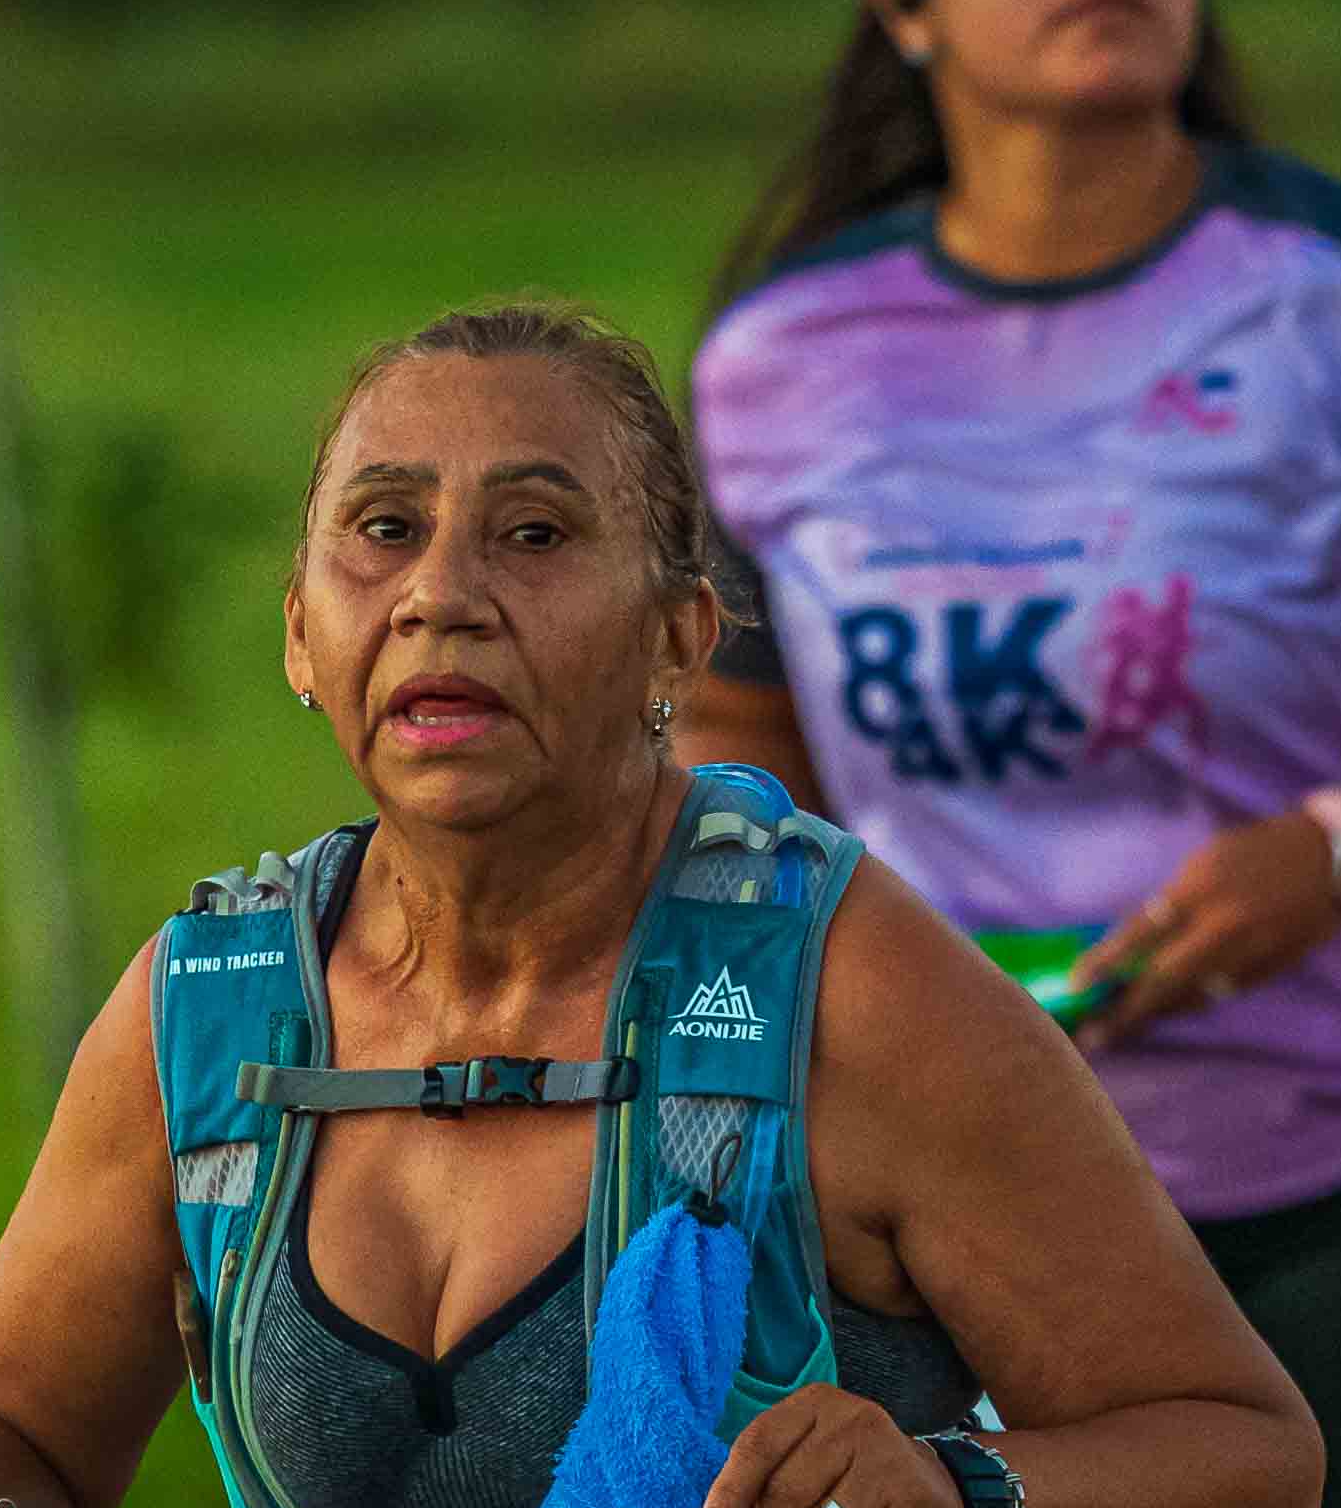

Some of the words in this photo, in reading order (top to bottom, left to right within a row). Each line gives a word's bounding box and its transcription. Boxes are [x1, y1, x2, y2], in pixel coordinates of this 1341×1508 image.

[185, 956, 221, 973] WIND
[226, 950, 285, 971] TRACKER
[667, 1020, 765, 1041] AONIJIE
